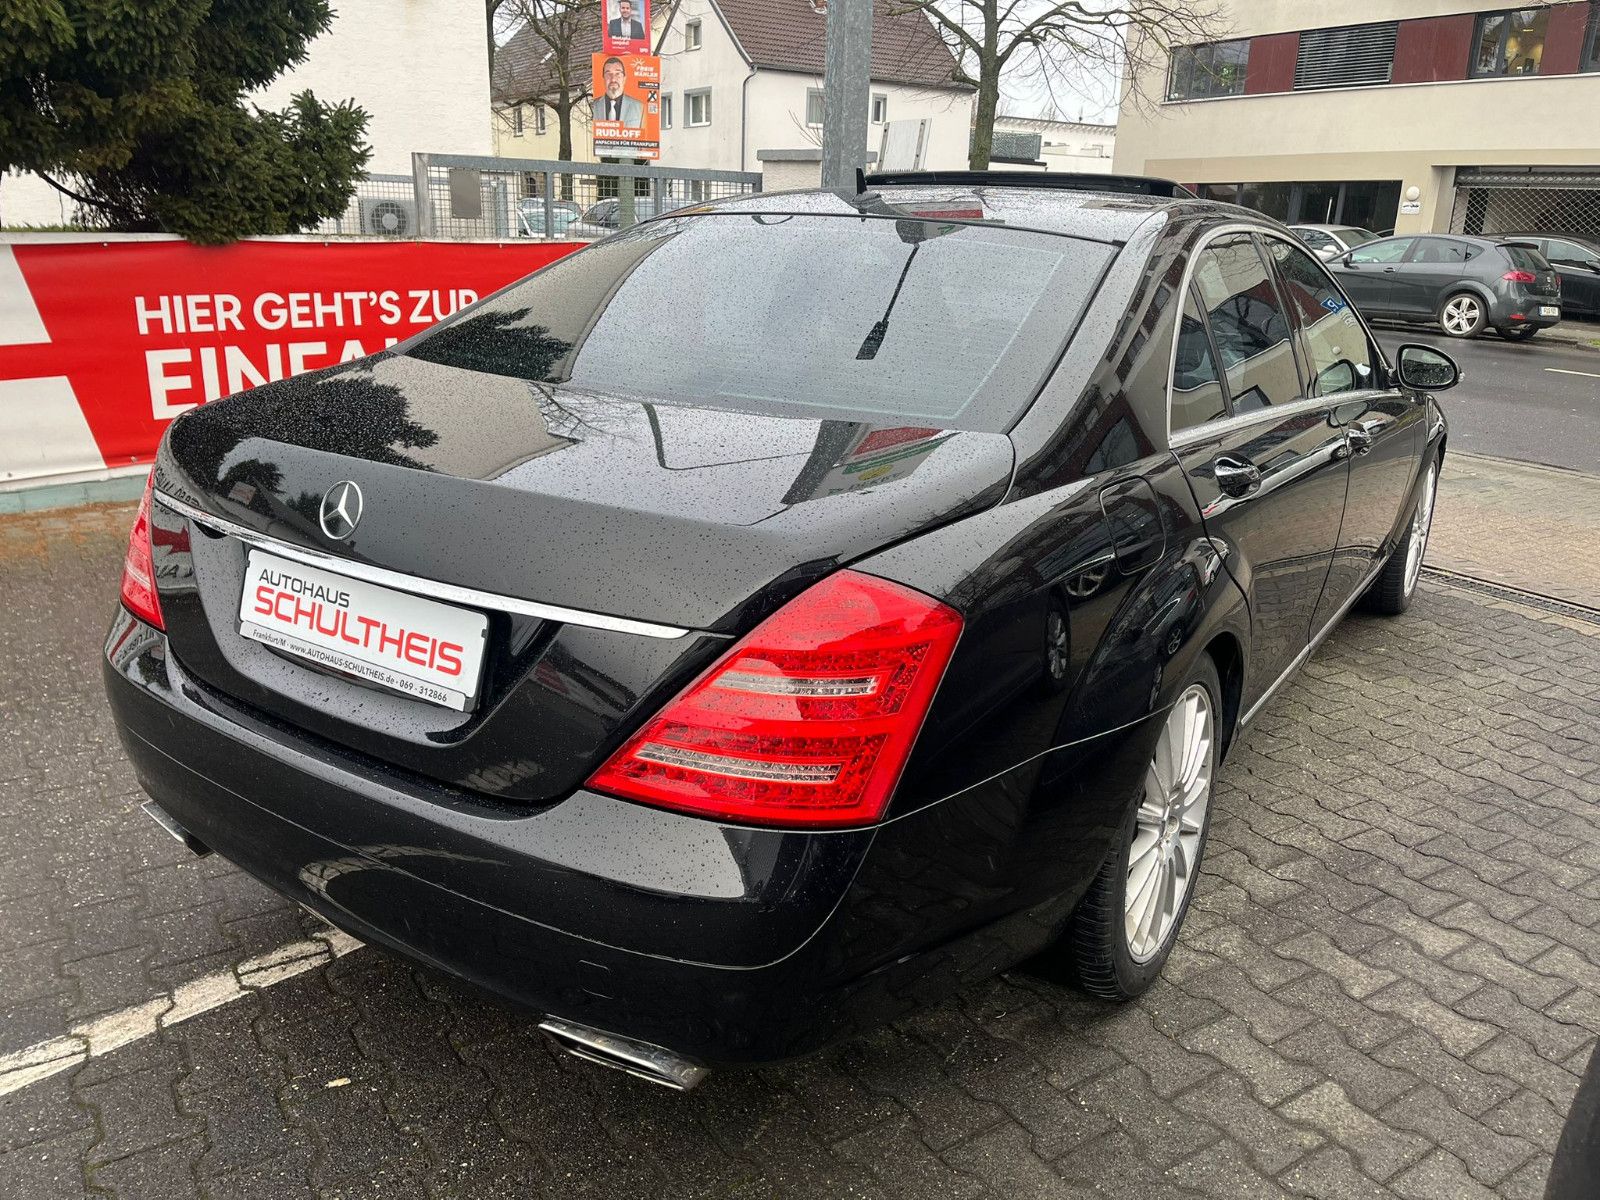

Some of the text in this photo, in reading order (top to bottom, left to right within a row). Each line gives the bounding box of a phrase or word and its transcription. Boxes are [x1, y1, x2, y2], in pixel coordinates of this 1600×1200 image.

[595, 128, 641, 138] RUDLOFF
[134, 294, 245, 335] HIER
[259, 569, 350, 608] AUTOHAUS
[254, 585, 464, 676] SCHULTHEIS
[290, 643, 395, 684] www.AUTOHAUS-SCHULTHEIS.de
[400, 679, 414, 691] 069
[419, 686, 447, 702] 312866
